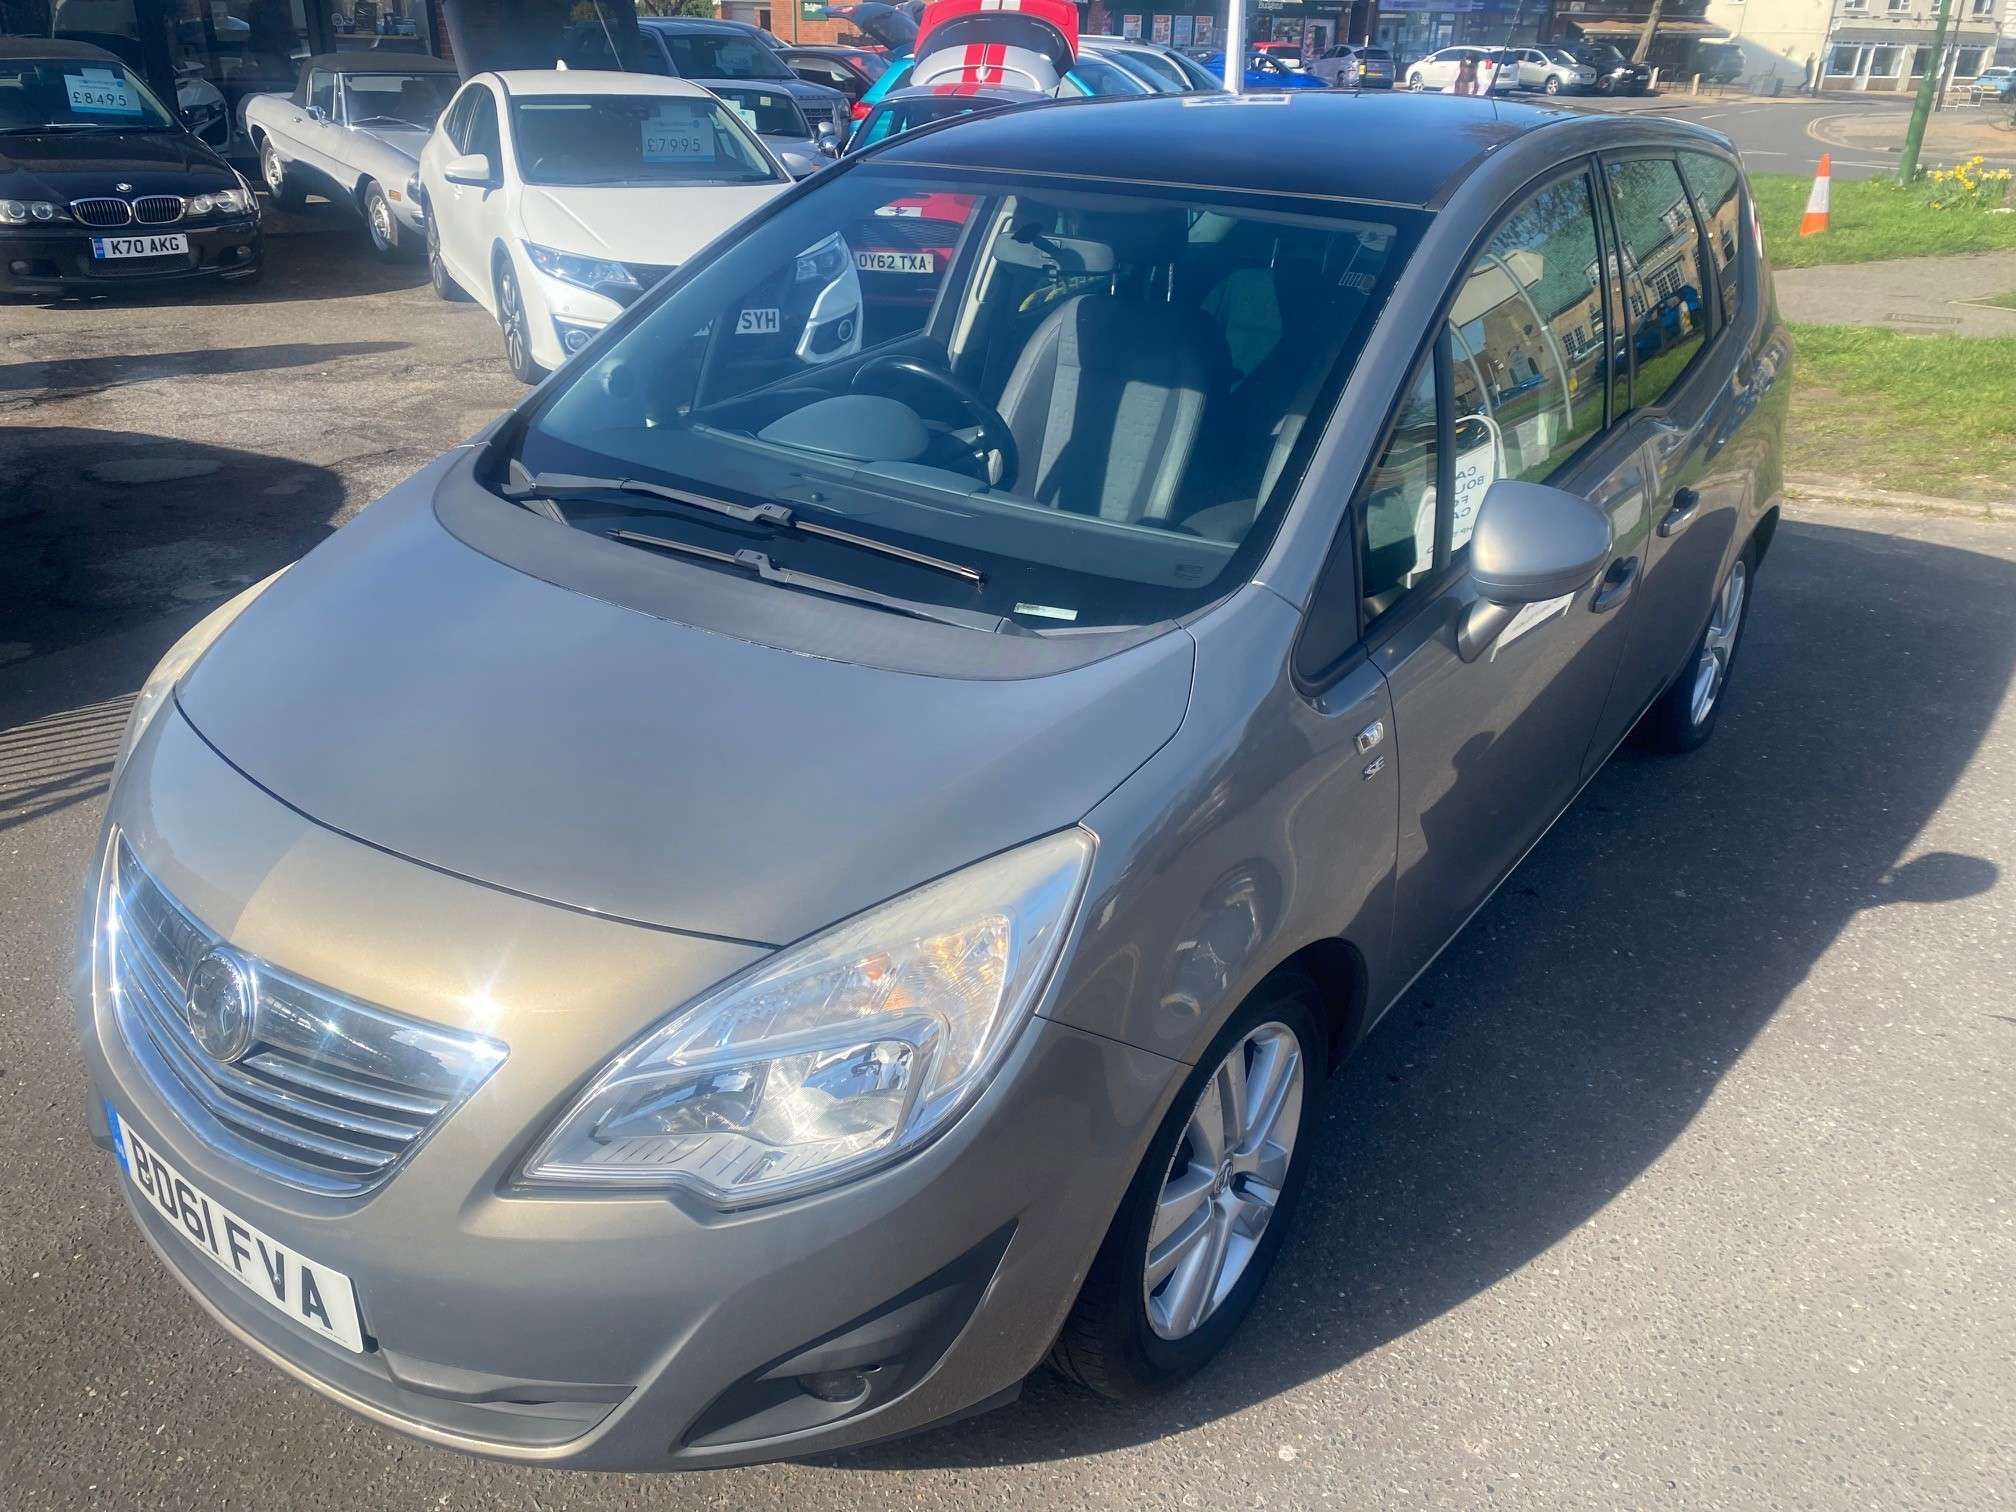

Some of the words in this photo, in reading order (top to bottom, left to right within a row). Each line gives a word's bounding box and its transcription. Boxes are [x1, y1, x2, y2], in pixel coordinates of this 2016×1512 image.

[73, 91, 127, 107] £8495
[647, 137, 701, 152] £7995
[110, 239, 144, 255] K70
[150, 237, 180, 252] AKG
[859, 254, 895, 269] OY62
[899, 255, 927, 271] TXA
[741, 311, 776, 329] SYH
[127, 1128, 219, 1256] BD61
[223, 1214, 334, 1331] FVA
